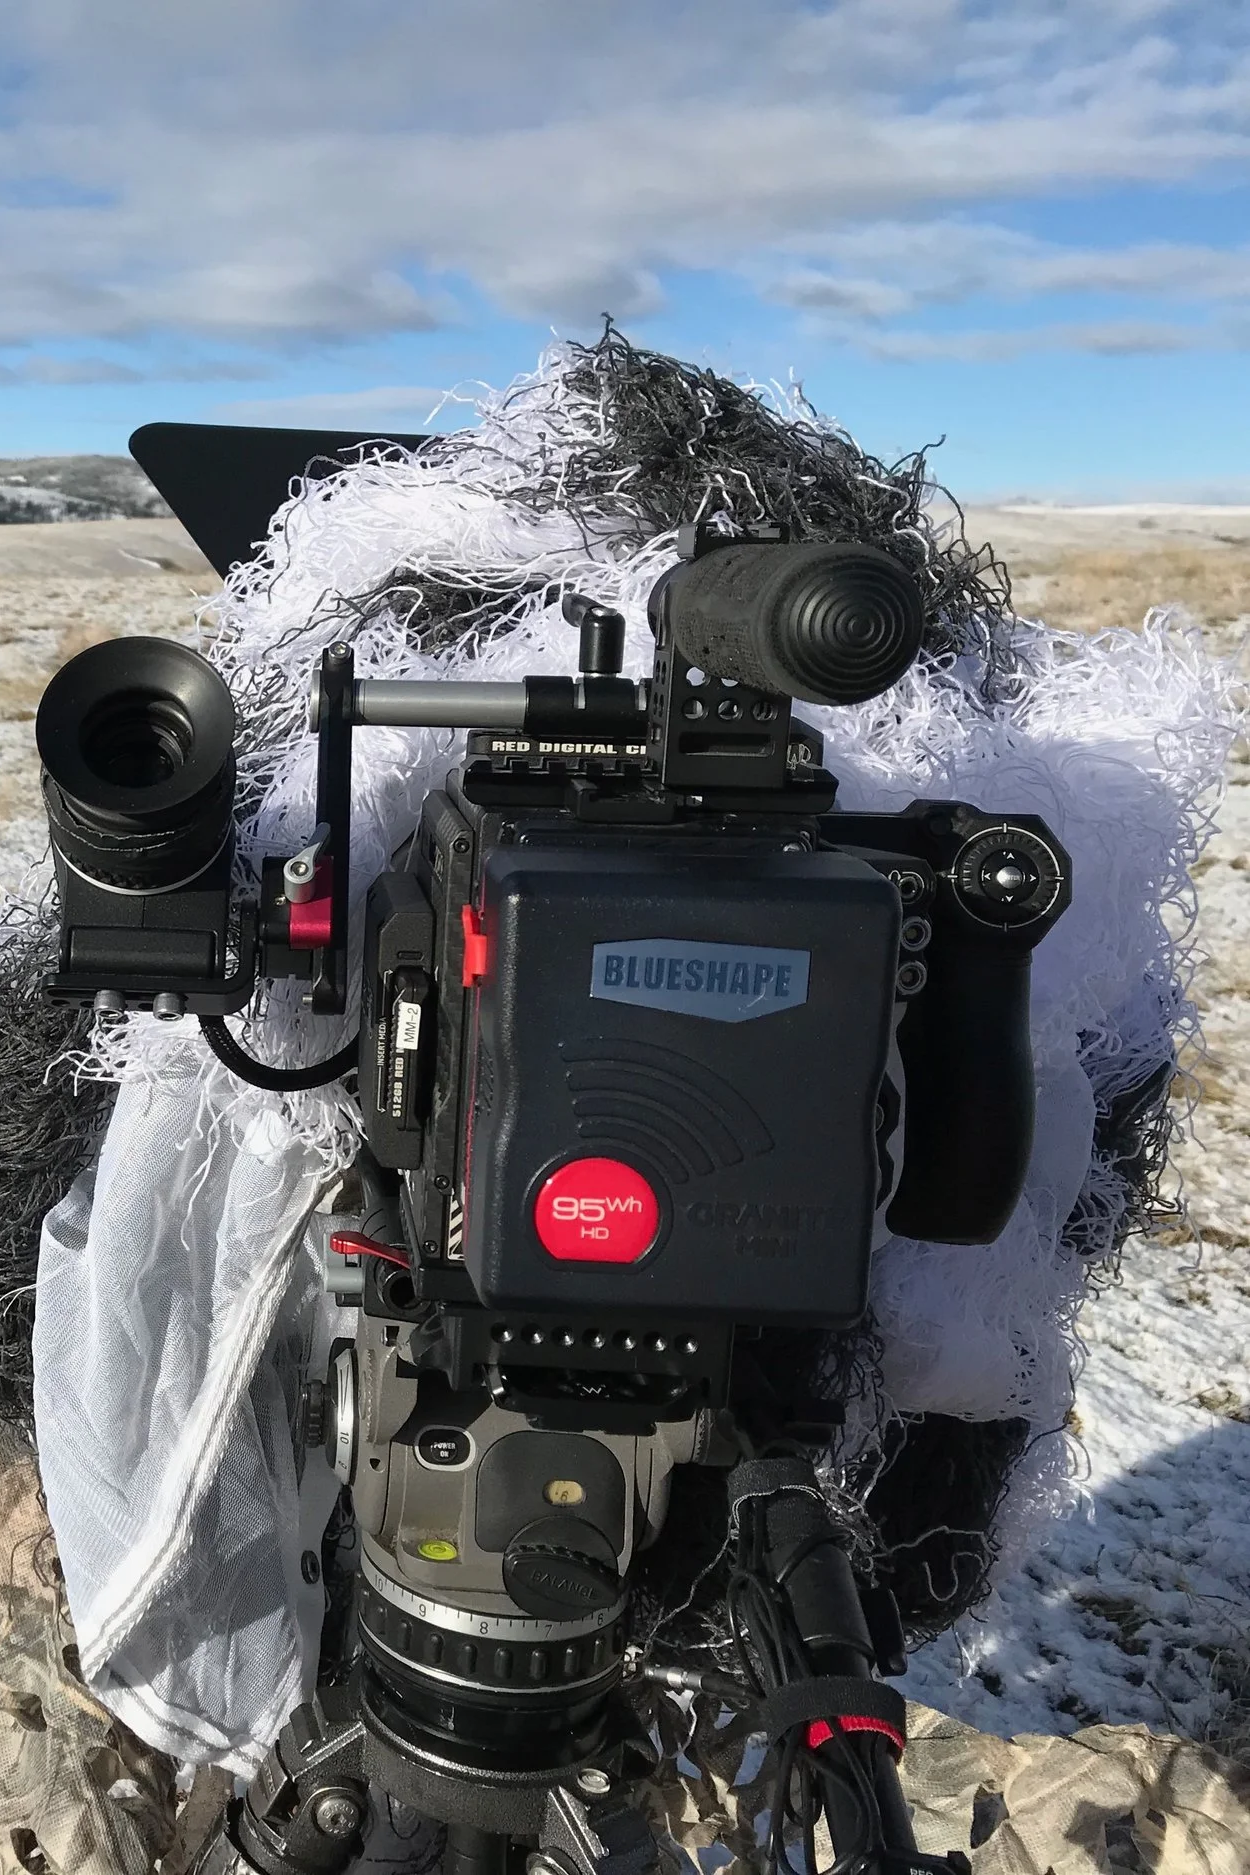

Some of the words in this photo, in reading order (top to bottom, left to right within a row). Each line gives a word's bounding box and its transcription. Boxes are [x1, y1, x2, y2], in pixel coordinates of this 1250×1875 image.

[491, 740, 530, 753] RED
[539, 741, 618, 755] DIGITAL
[603, 954, 793, 998] BLUESHAPE
[378, 1016, 387, 1038] MEDIA
[404, 1007, 418, 1042] MM-2
[377, 1040, 386, 1066] INSERT
[395, 1057, 404, 1077] RED
[393, 1082, 402, 1117] 512GB
[580, 1226, 610, 1241] HD
[339, 1430, 350, 1446] 10
[433, 1441, 456, 1450] POWER
[373, 1573, 385, 1593] 10
[418, 1603, 428, 1618] 9
[597, 1612, 605, 1626] 6
[479, 1621, 489, 1636] 8
[544, 1623, 553, 1639] 7
